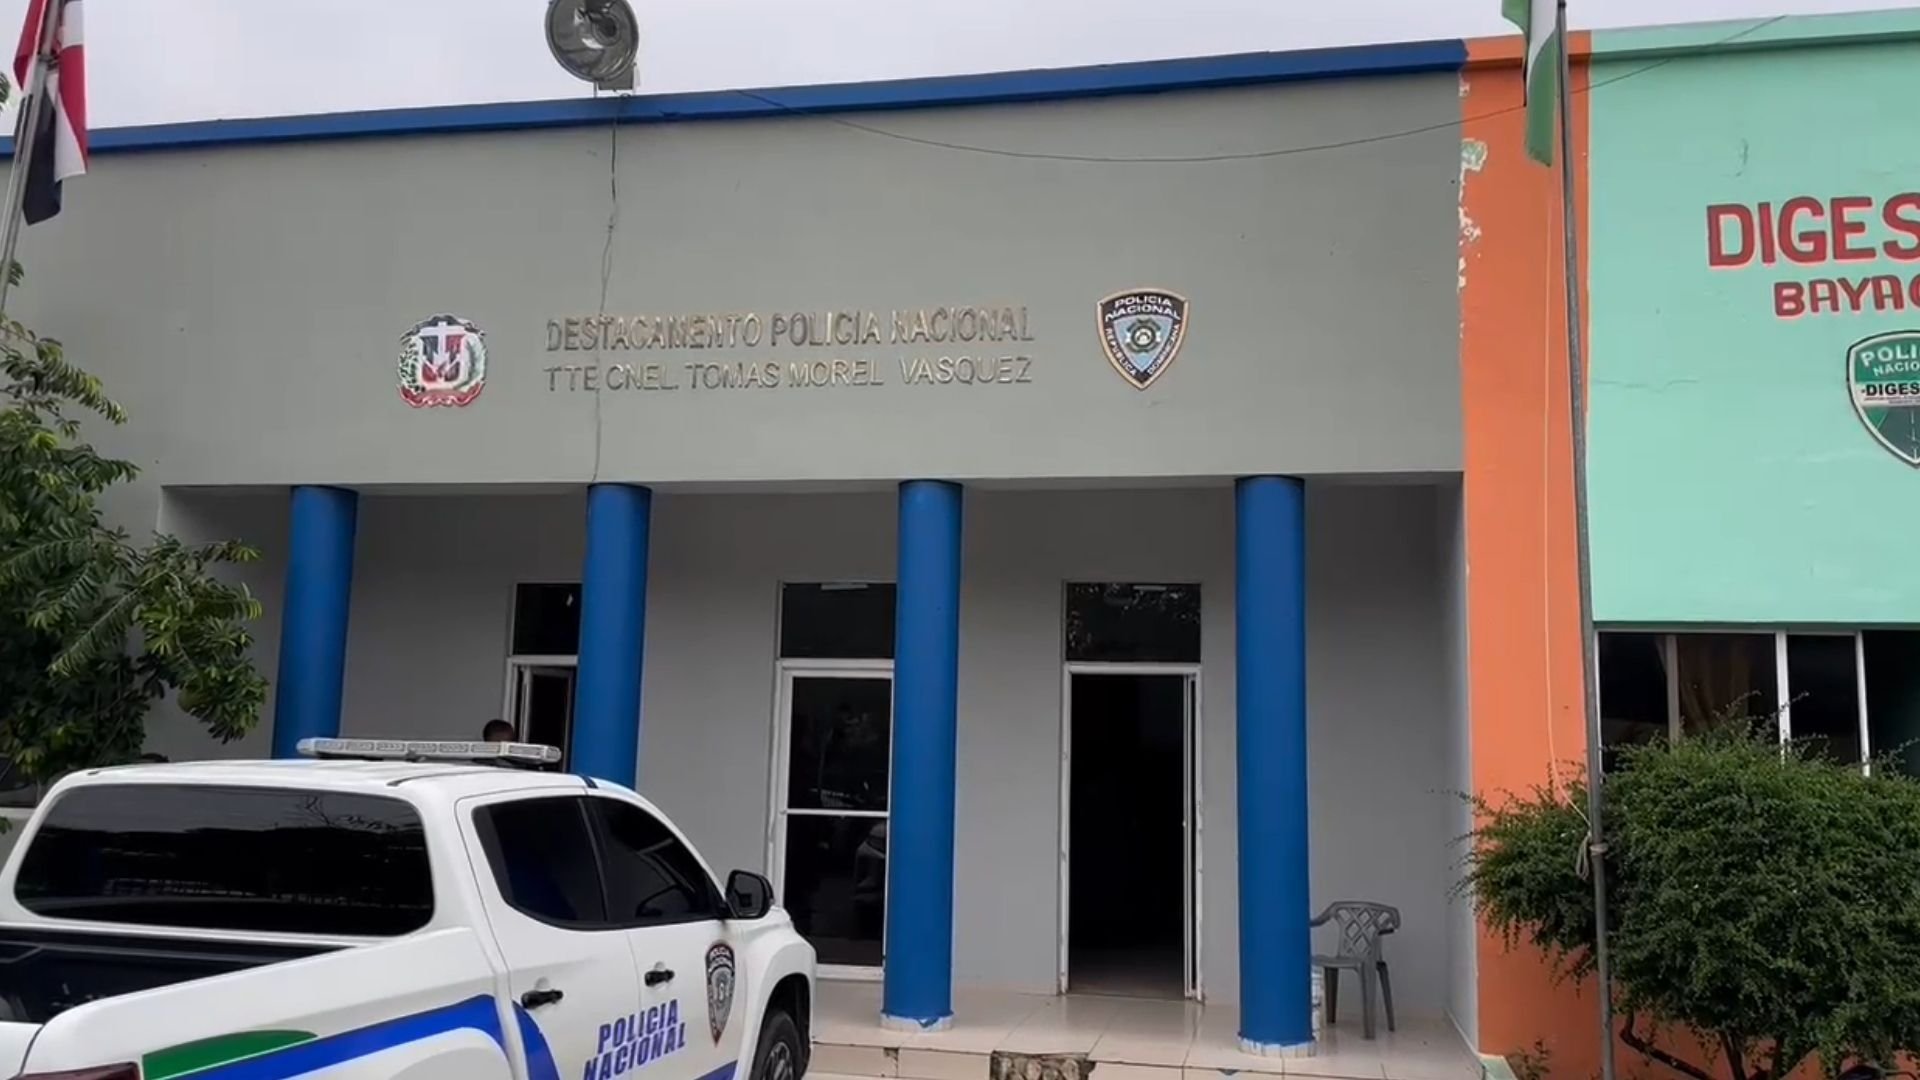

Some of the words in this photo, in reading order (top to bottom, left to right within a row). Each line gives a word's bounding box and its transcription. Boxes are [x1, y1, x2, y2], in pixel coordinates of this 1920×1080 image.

[1706, 192, 1920, 267] DIGES
[1105, 304, 1181, 322] NACIONAL
[1114, 295, 1172, 308] POLICIA
[546, 312, 762, 351] DESTACAMENTO
[771, 311, 882, 347] POLICIA
[891, 306, 1035, 345] NACIONAL
[544, 364, 601, 392] TTE
[685, 361, 781, 390] TOMAS
[789, 358, 885, 389] MOREL
[899, 355, 1033, 386] VASQUEZ
[1861, 344, 1920, 367] POLI
[1872, 361, 1920, 377] NACIO
[597, 998, 680, 1055] POLICIA
[582, 1022, 686, 1080] NACIONAL
